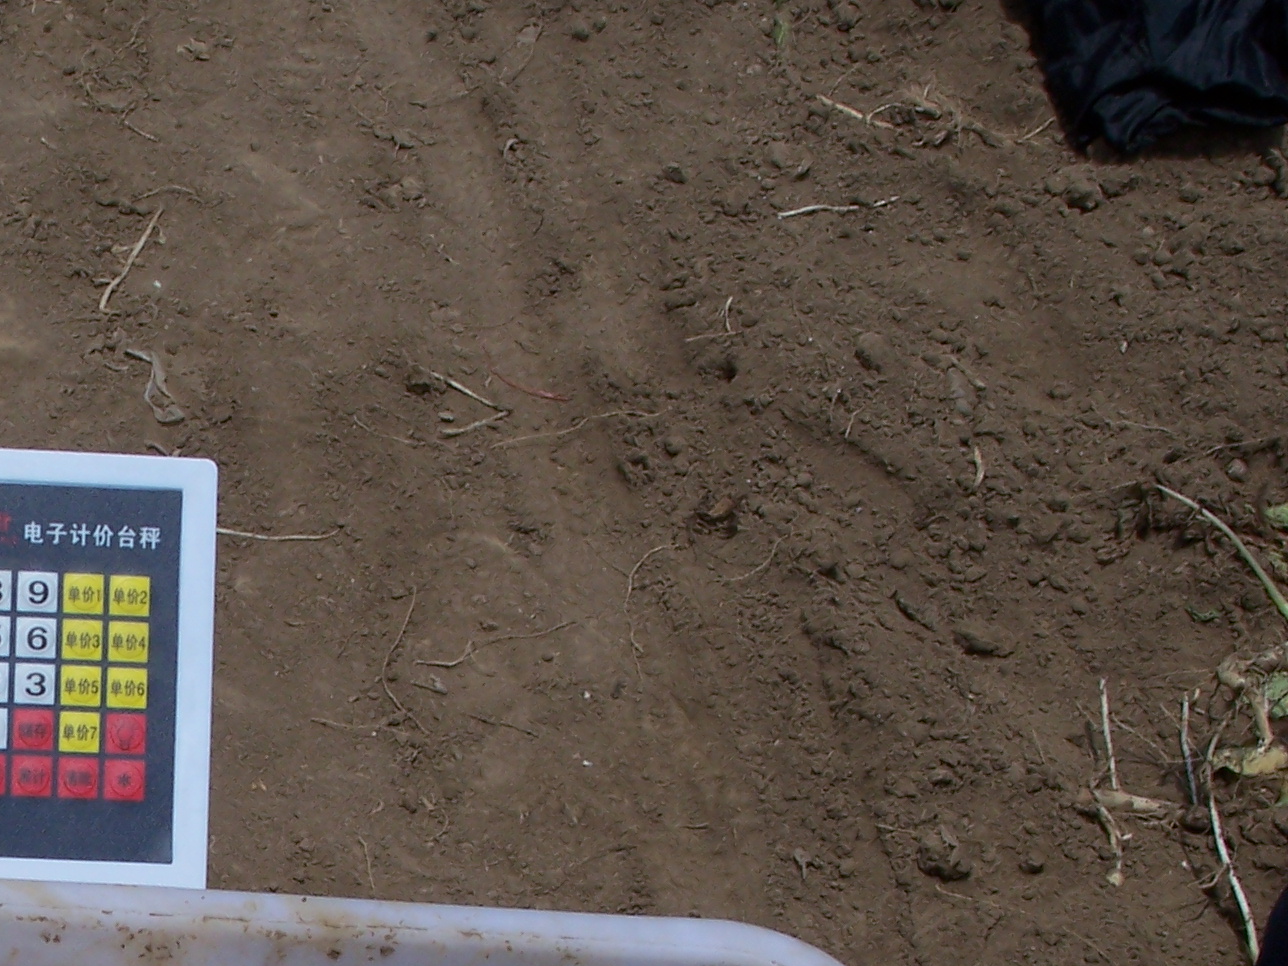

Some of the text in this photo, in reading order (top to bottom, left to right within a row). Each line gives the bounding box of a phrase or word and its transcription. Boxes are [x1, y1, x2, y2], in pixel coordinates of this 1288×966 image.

[23, 520, 162, 549] 电子计价台秤
[28, 580, 49, 604] 9
[68, 586, 101, 604] 单价1
[113, 588, 147, 605] 单价2
[27, 626, 48, 651] 6
[66, 631, 100, 649] 单价3
[111, 633, 146, 651] 单价4
[25, 672, 46, 696] 3
[64, 678, 98, 696] 单价5
[110, 680, 145, 697] 单价6
[63, 723, 97, 741] 单价7
